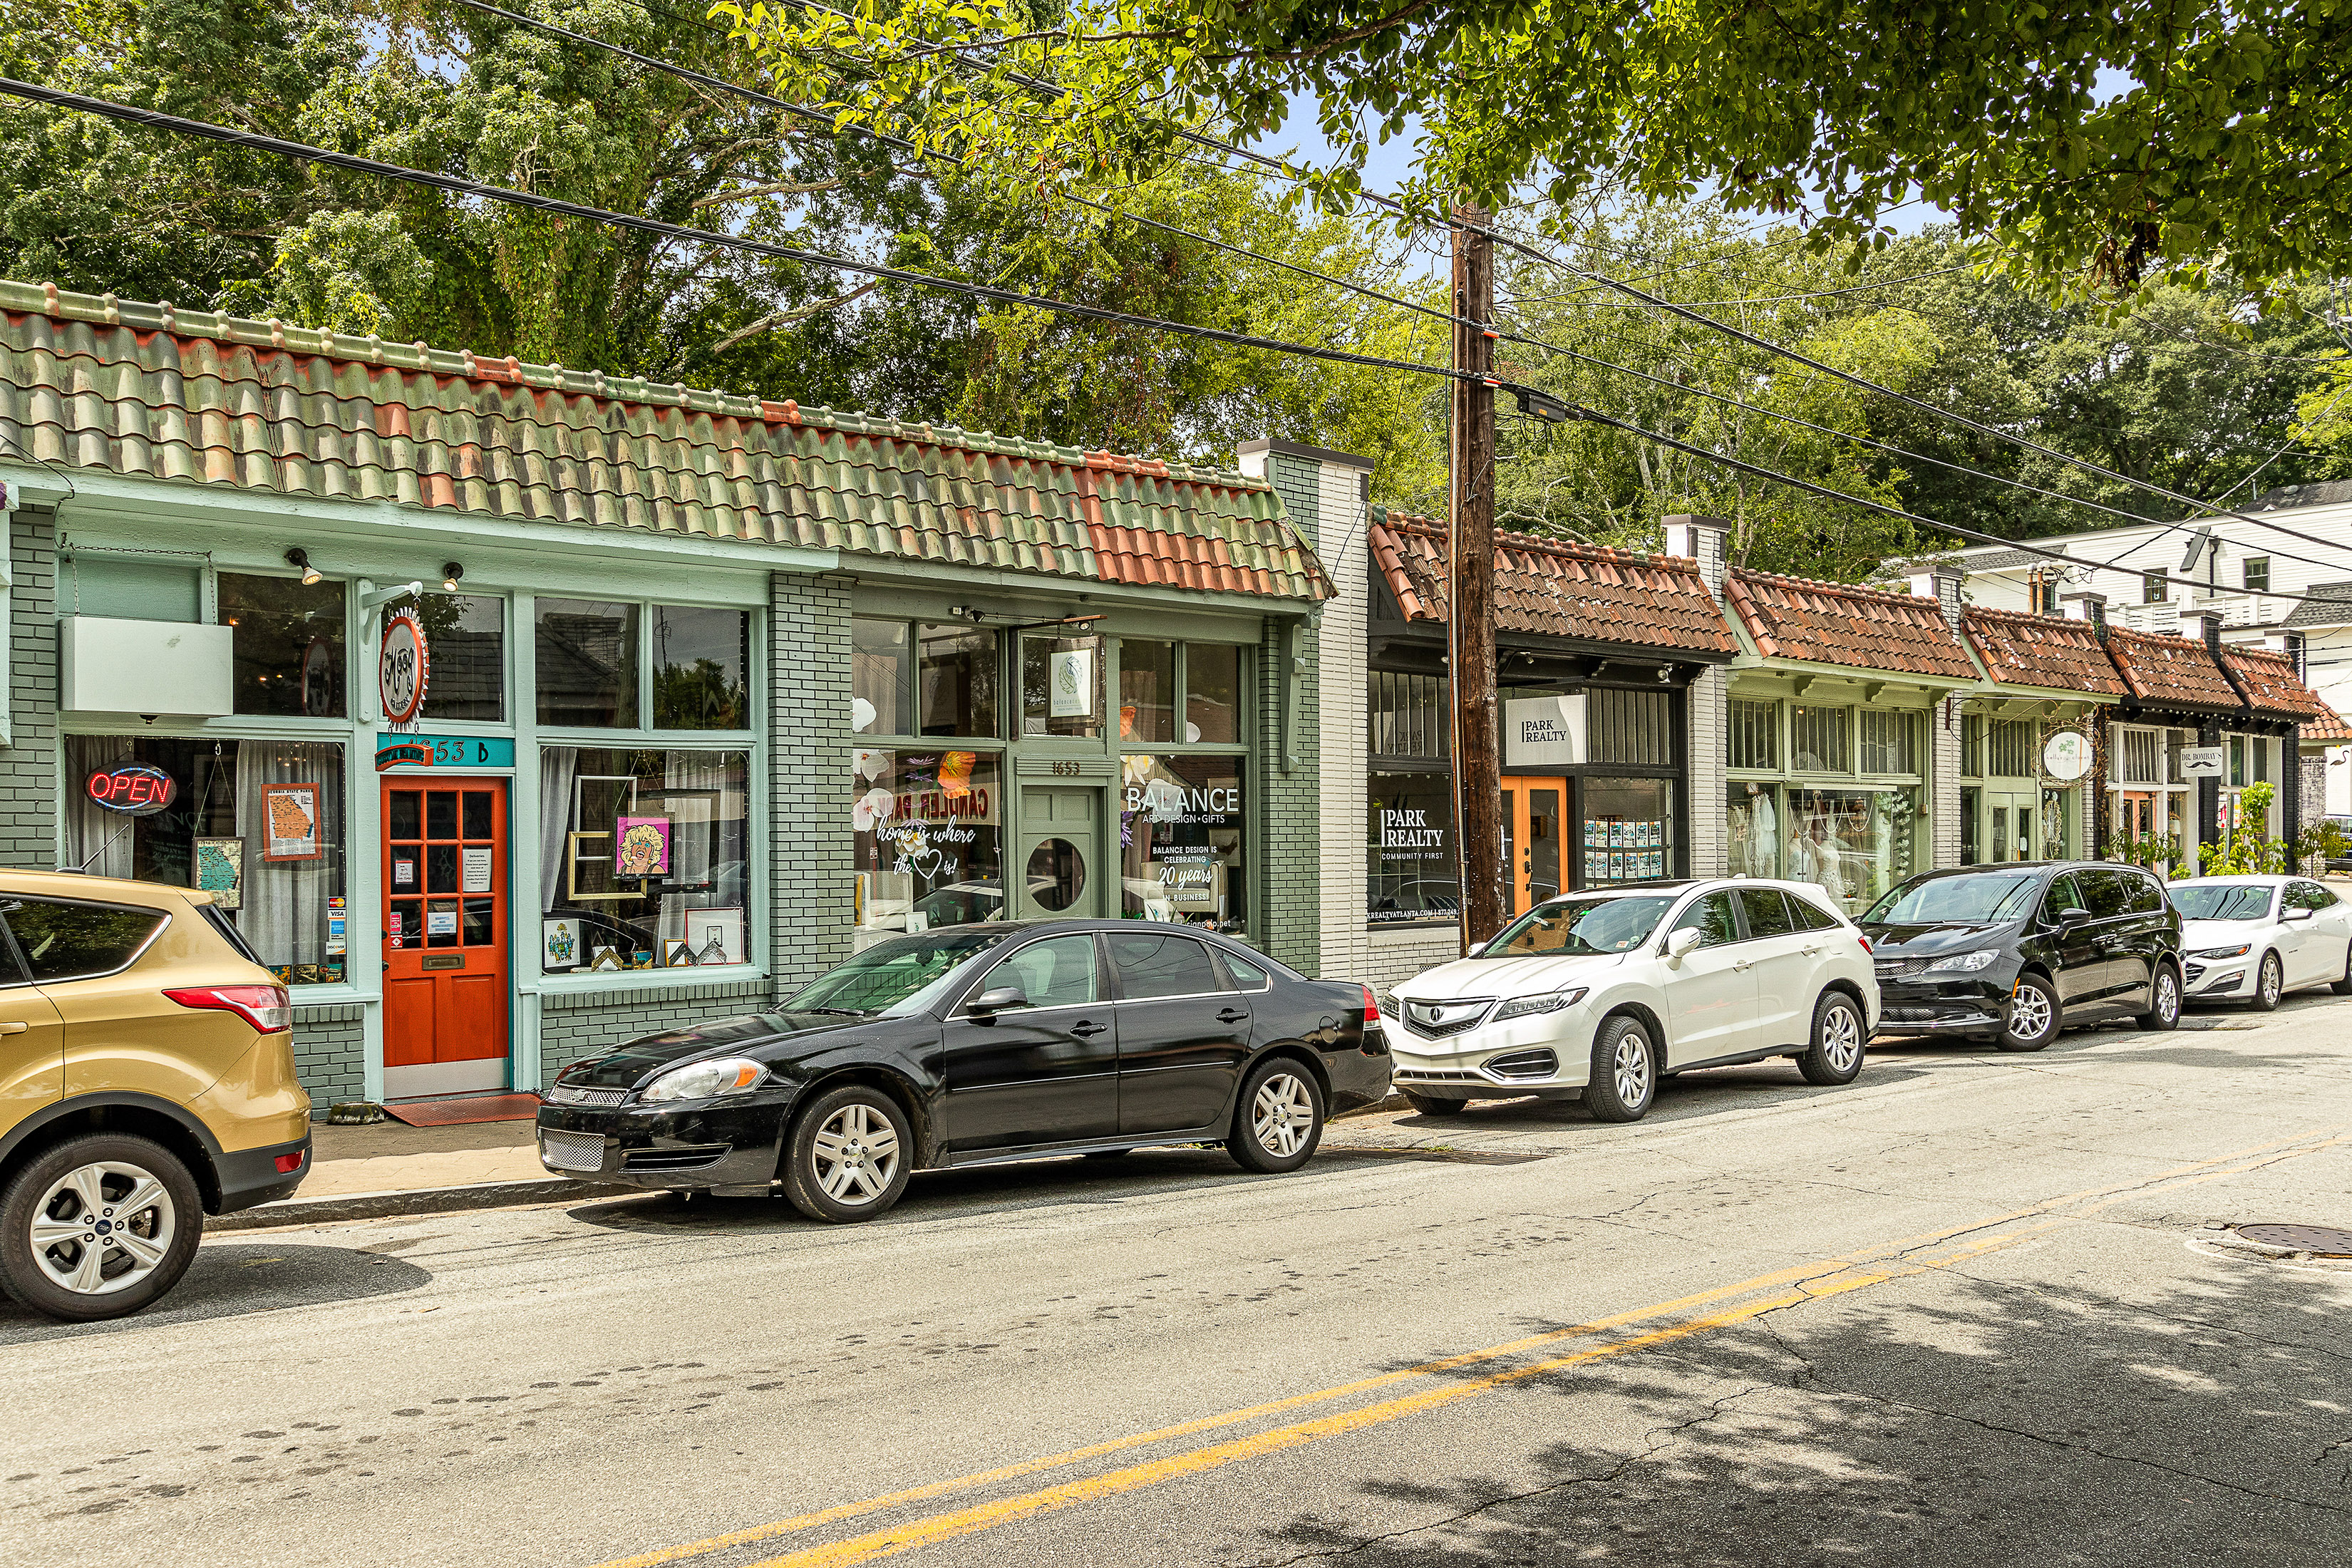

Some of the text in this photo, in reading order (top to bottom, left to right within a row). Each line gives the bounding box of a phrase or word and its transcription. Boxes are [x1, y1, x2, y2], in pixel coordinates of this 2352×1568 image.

[385, 644, 416, 696] Moog
[1525, 720, 1554, 731] PARK
[1525, 731, 1567, 743] REALTY
[478, 742, 489, 763] B
[2193, 752, 2222, 760] BOMBAY'S
[1053, 761, 1080, 775] 1653
[90, 773, 170, 803] OPEN
[1128, 788, 1239, 812] BALANCE
[1202, 814, 1225, 823] GIFTS
[1386, 809, 1427, 827] PARK
[877, 814, 976, 843] home is where
[1386, 830, 1444, 847] REALTY
[1152, 846, 1183, 855] BALANCE
[892, 852, 913, 875] the
[944, 857, 958, 875] is!
[1164, 855, 1207, 864] CELEBRATING
[1157, 866, 1213, 891] 20 years
[1174, 893, 1209, 902] BUSINESS!
